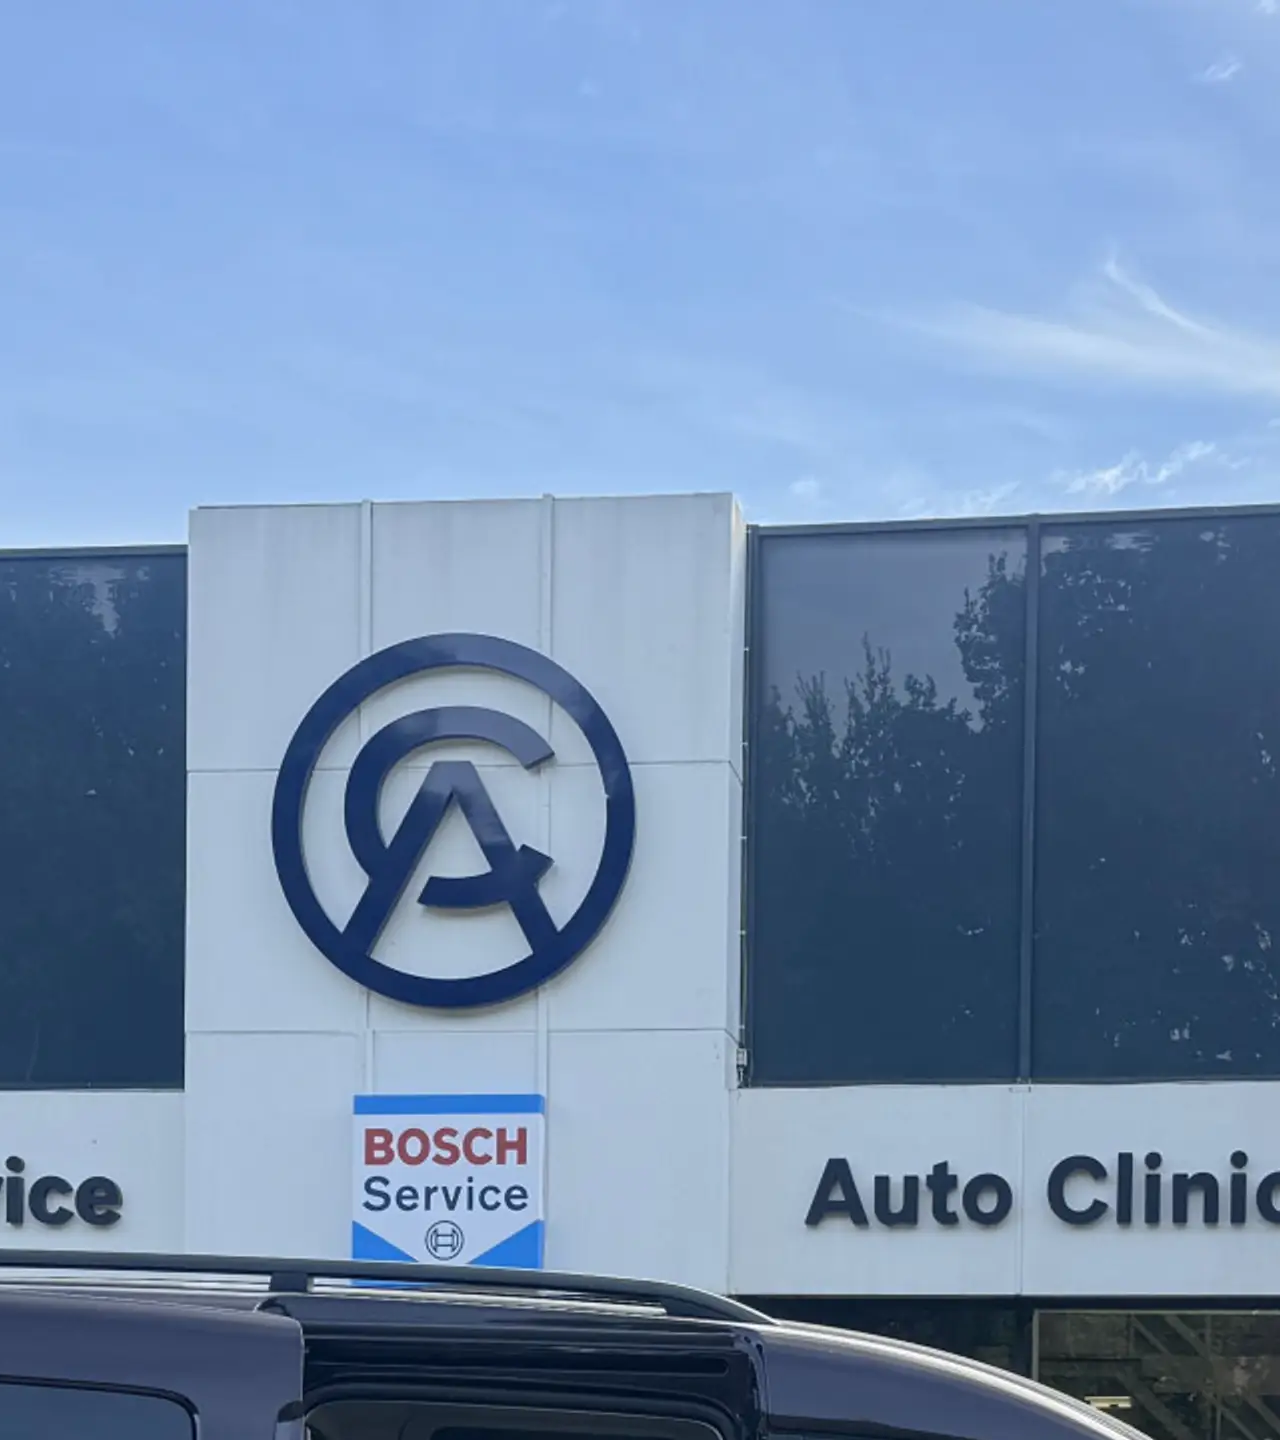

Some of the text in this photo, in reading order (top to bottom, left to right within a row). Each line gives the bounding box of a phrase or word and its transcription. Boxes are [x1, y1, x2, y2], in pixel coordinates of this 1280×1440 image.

[364, 1127, 528, 1166] BOSCH
[362, 1175, 530, 1213] Service
[804, 1157, 1014, 1230] Auto
